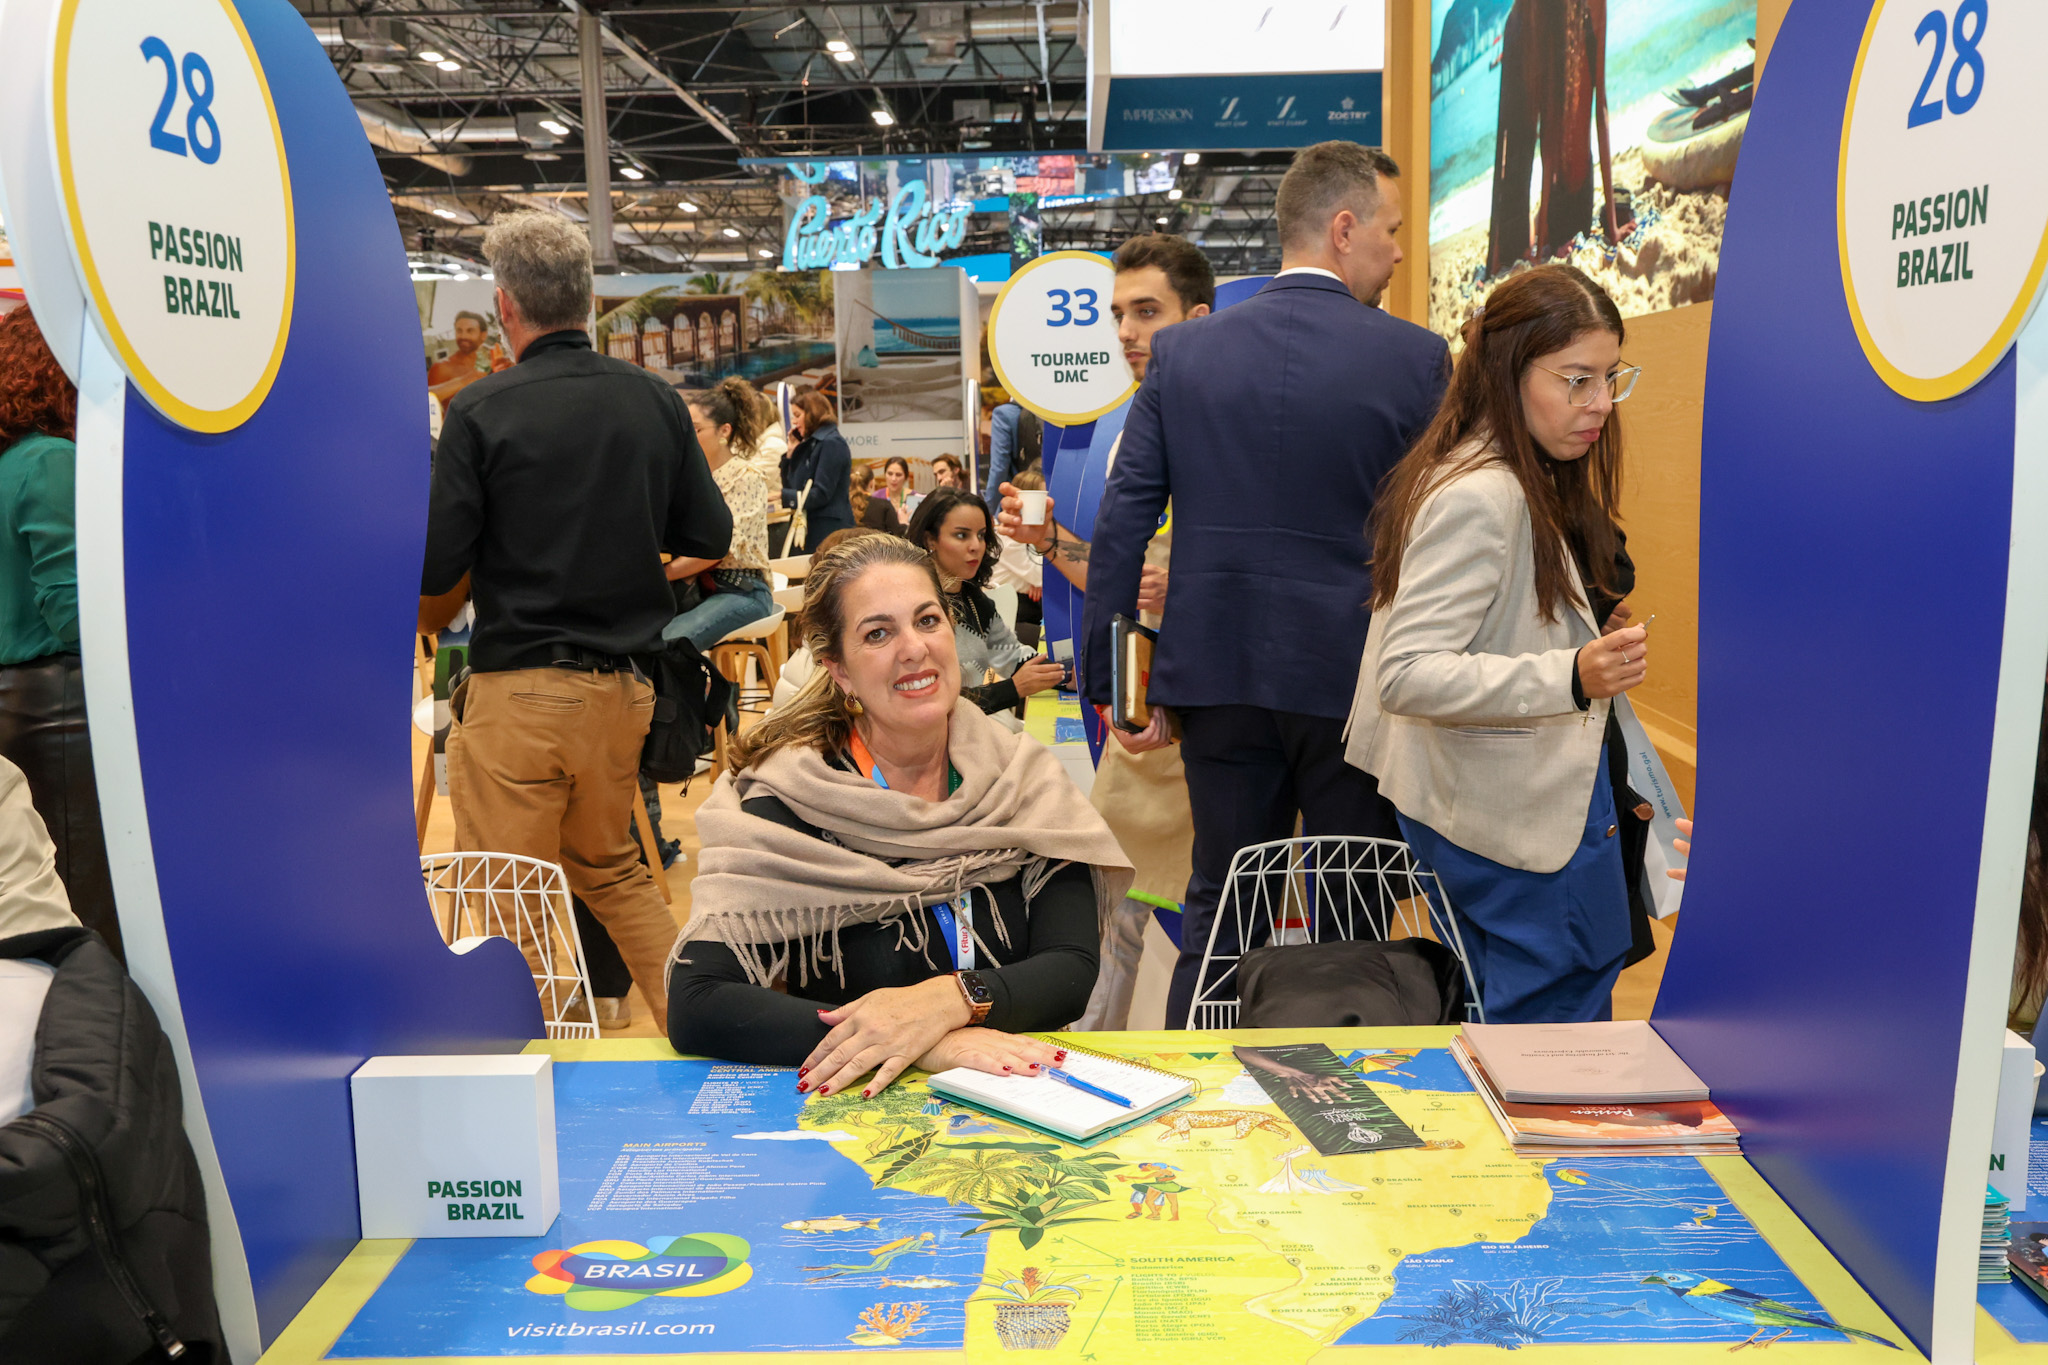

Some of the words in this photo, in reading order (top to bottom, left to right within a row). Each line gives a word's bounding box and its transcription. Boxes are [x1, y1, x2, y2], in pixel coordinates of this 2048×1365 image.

[1907, 0, 1988, 130] 28
[139, 36, 222, 165] 28
[782, 195, 884, 271] Puerto
[881, 179, 975, 269] Rico
[1892, 184, 1988, 240] PASSION
[148, 221, 243, 272] PASSION
[1896, 243, 1973, 288] BRAZIL
[164, 275, 240, 319] BRAZIL
[1046, 288, 1099, 327] 33
[1031, 352, 1110, 367] TOURMED
[1054, 370, 1088, 383] DMC
[1639, 751, 1672, 818] www.turismo.gal
[428, 1180, 522, 1198] PASSION
[448, 1203, 524, 1220] BRAZIL
[584, 1264, 704, 1278] BRASIL
[508, 1322, 715, 1337] visitbrasil.com
